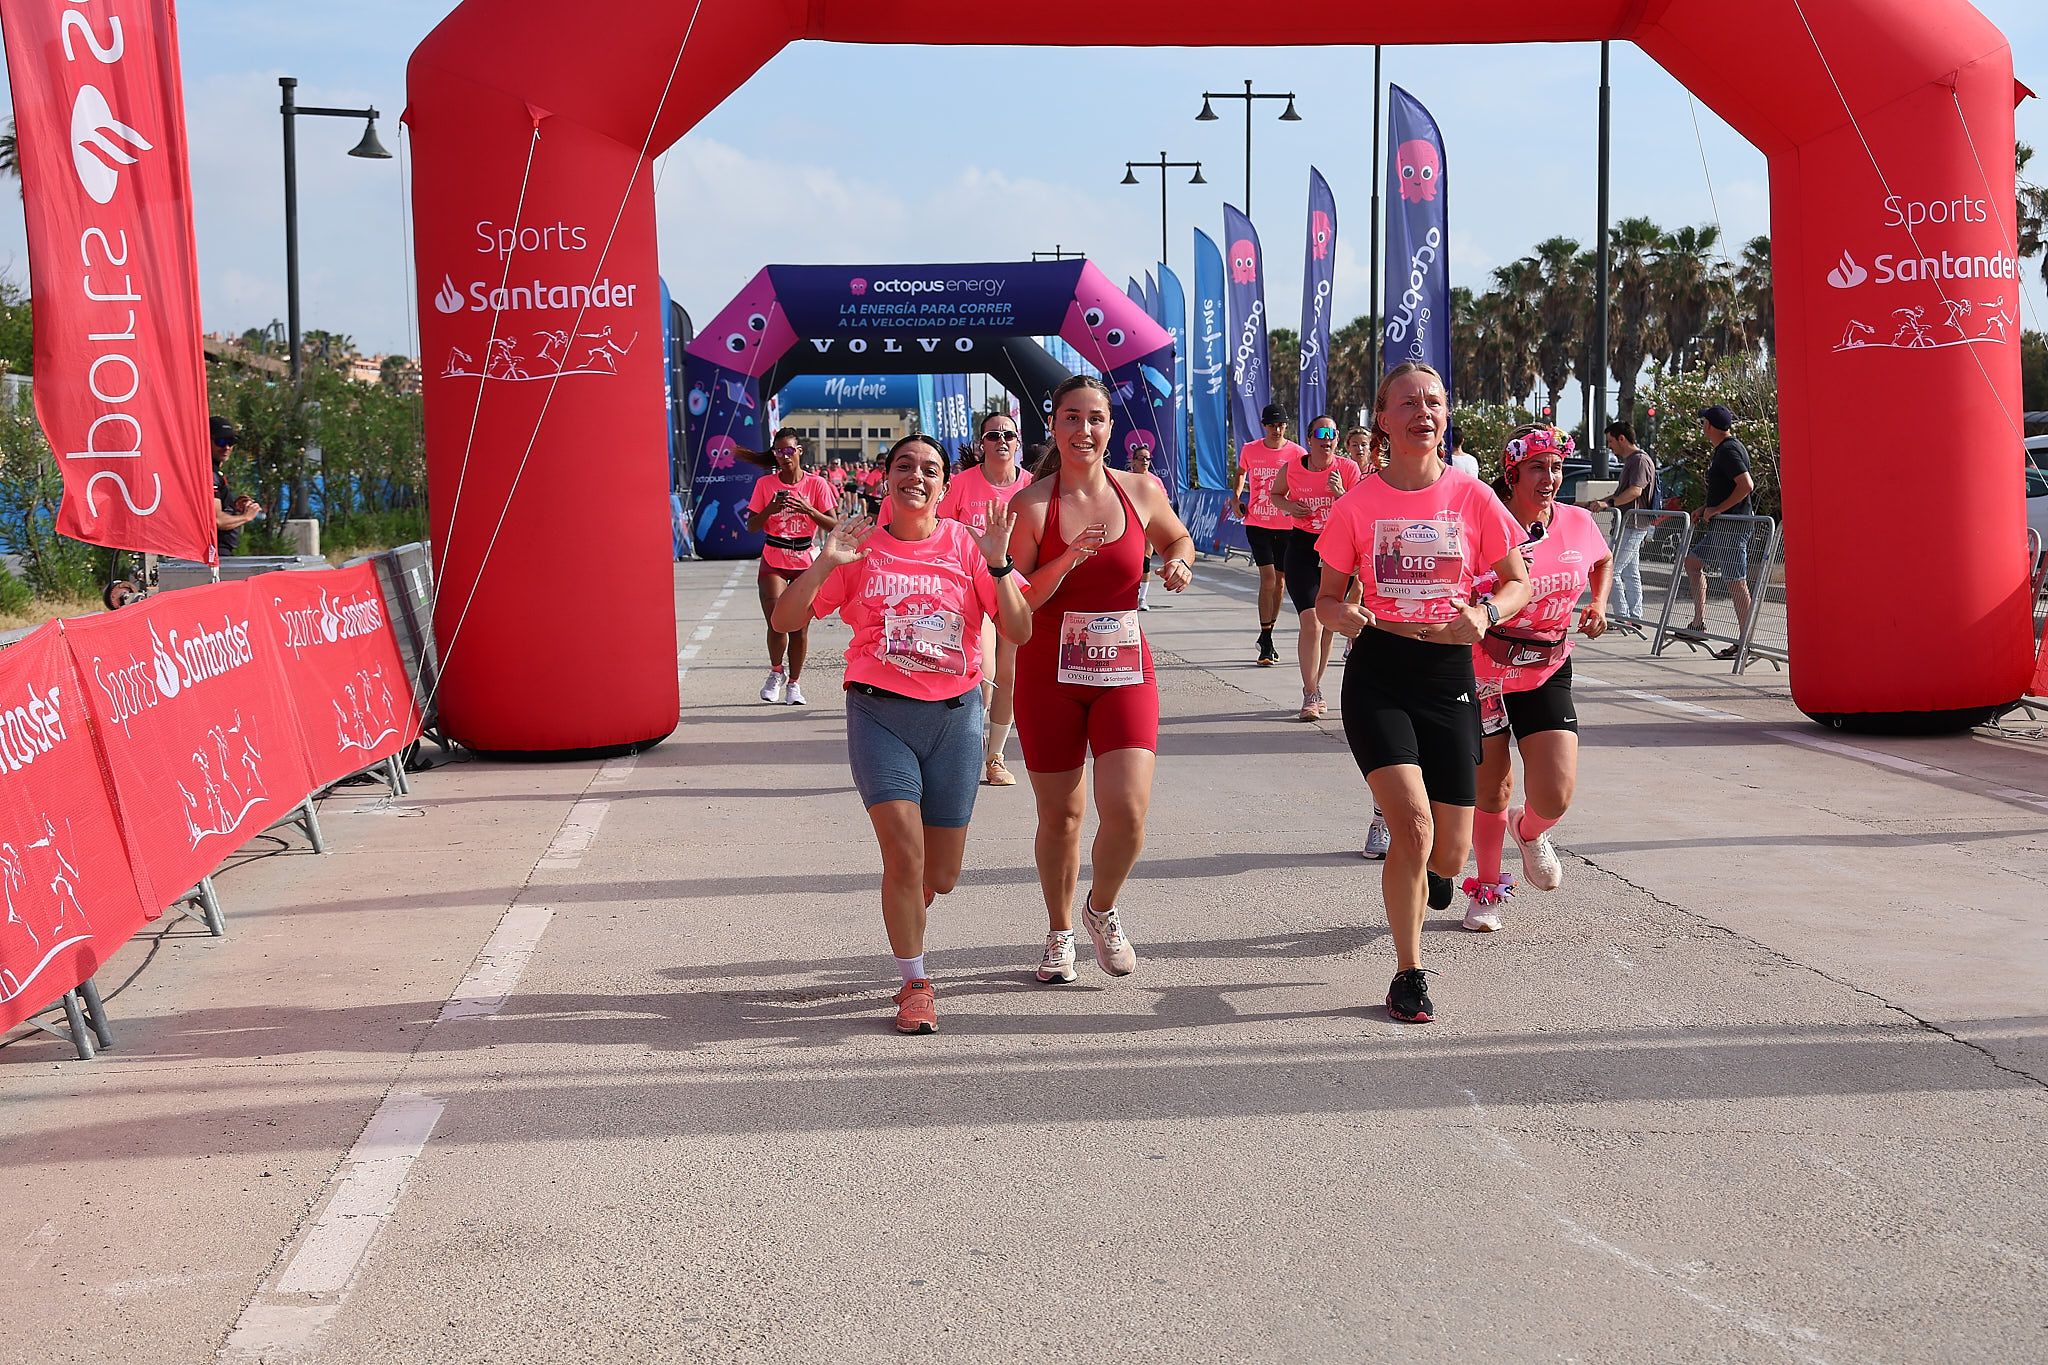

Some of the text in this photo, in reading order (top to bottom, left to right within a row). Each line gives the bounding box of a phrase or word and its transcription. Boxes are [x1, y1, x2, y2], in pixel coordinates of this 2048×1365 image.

[1884, 195, 1987, 233] Sports
[476, 220, 587, 260] Sports
[1875, 250, 2016, 283] Santander
[470, 278, 637, 311] Santander
[873, 279, 1005, 297] octopus energy
[840, 301, 1012, 314] LA ENERGÍA PARA CORRER
[838, 317, 1015, 327] A LA VELOCIDAD DE LA LUZ
[810, 337, 974, 353] VOLVO
[824, 377, 887, 404] Marlene
[695, 474, 725, 484] octopus
[1253, 467, 1279, 477] CARRER
[1404, 531, 1436, 539] ASTURIANA
[1402, 556, 1436, 570] 016
[864, 573, 942, 598] CARRERA
[1385, 587, 1411, 595] OYSHO
[1531, 571, 1580, 598] RRERA
[1087, 646, 1118, 659] 016
[93, 614, 253, 739] Sports Santander
[1068, 672, 1094, 681] OYSHO
[0, 682, 67, 775] tander
